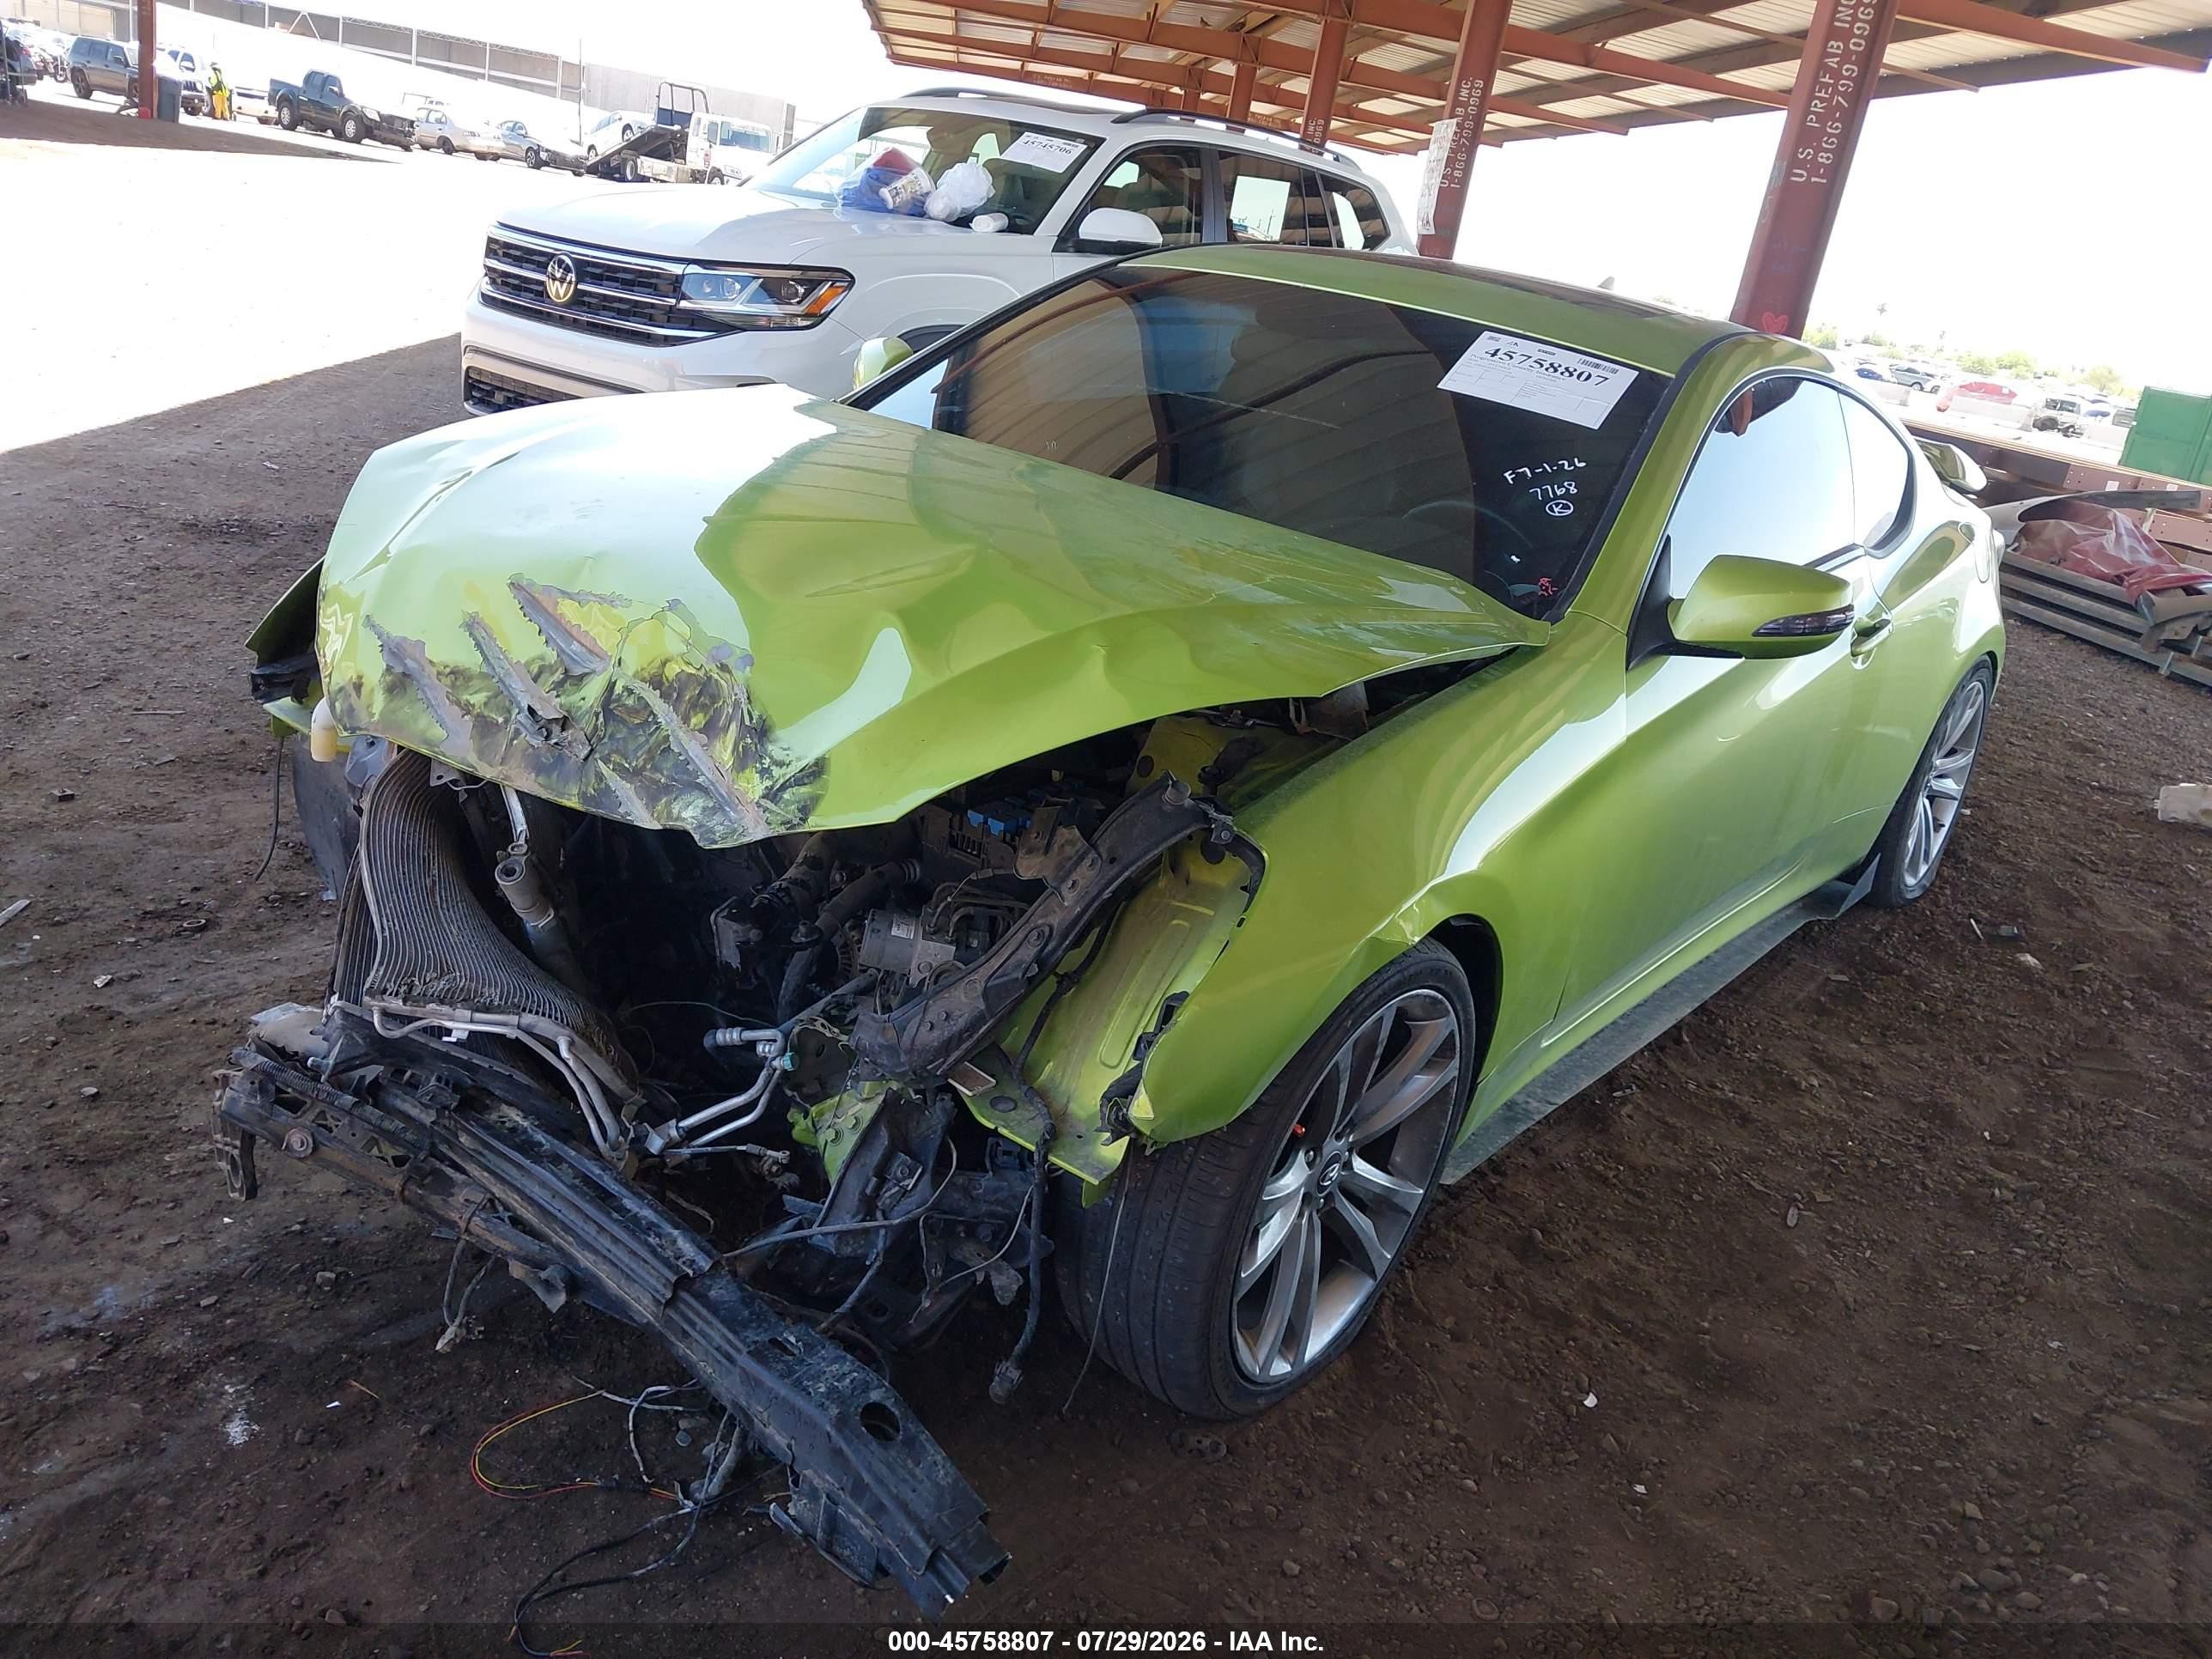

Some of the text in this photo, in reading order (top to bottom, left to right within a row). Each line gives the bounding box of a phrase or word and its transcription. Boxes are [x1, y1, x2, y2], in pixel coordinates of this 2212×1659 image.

[1458, 76, 1474, 101] INC.
[1790, 143, 1816, 182] U.S.
[1807, 40, 1844, 127] PREFAB
[1023, 139, 1073, 155] 45745706
[1450, 79, 1484, 188] 1-866-799-0969
[1485, 347, 1610, 387] 45758807
[1529, 481, 1578, 501] 7768
